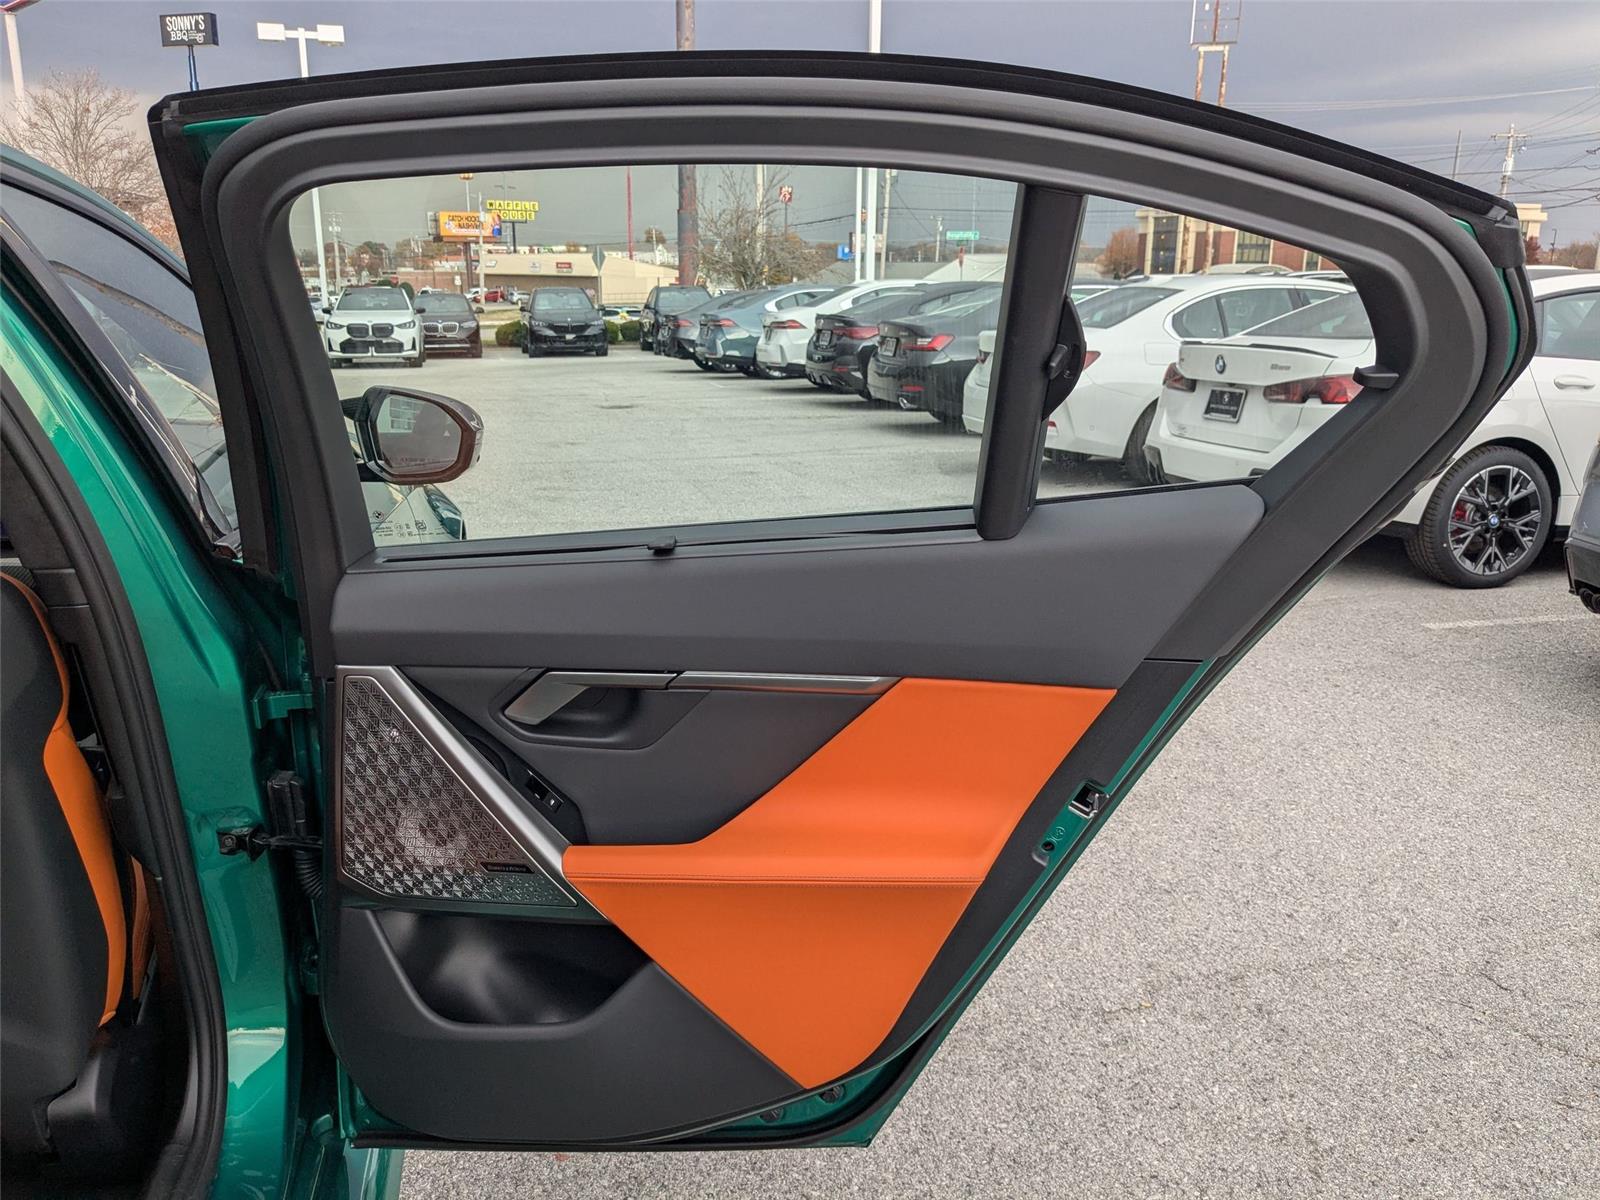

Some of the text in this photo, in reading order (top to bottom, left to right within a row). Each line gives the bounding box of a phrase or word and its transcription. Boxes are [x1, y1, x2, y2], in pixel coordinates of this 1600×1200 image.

[166, 15, 205, 31] SONNY'S
[170, 30, 188, 42] BBQ
[487, 201, 537, 210] WAFFLE
